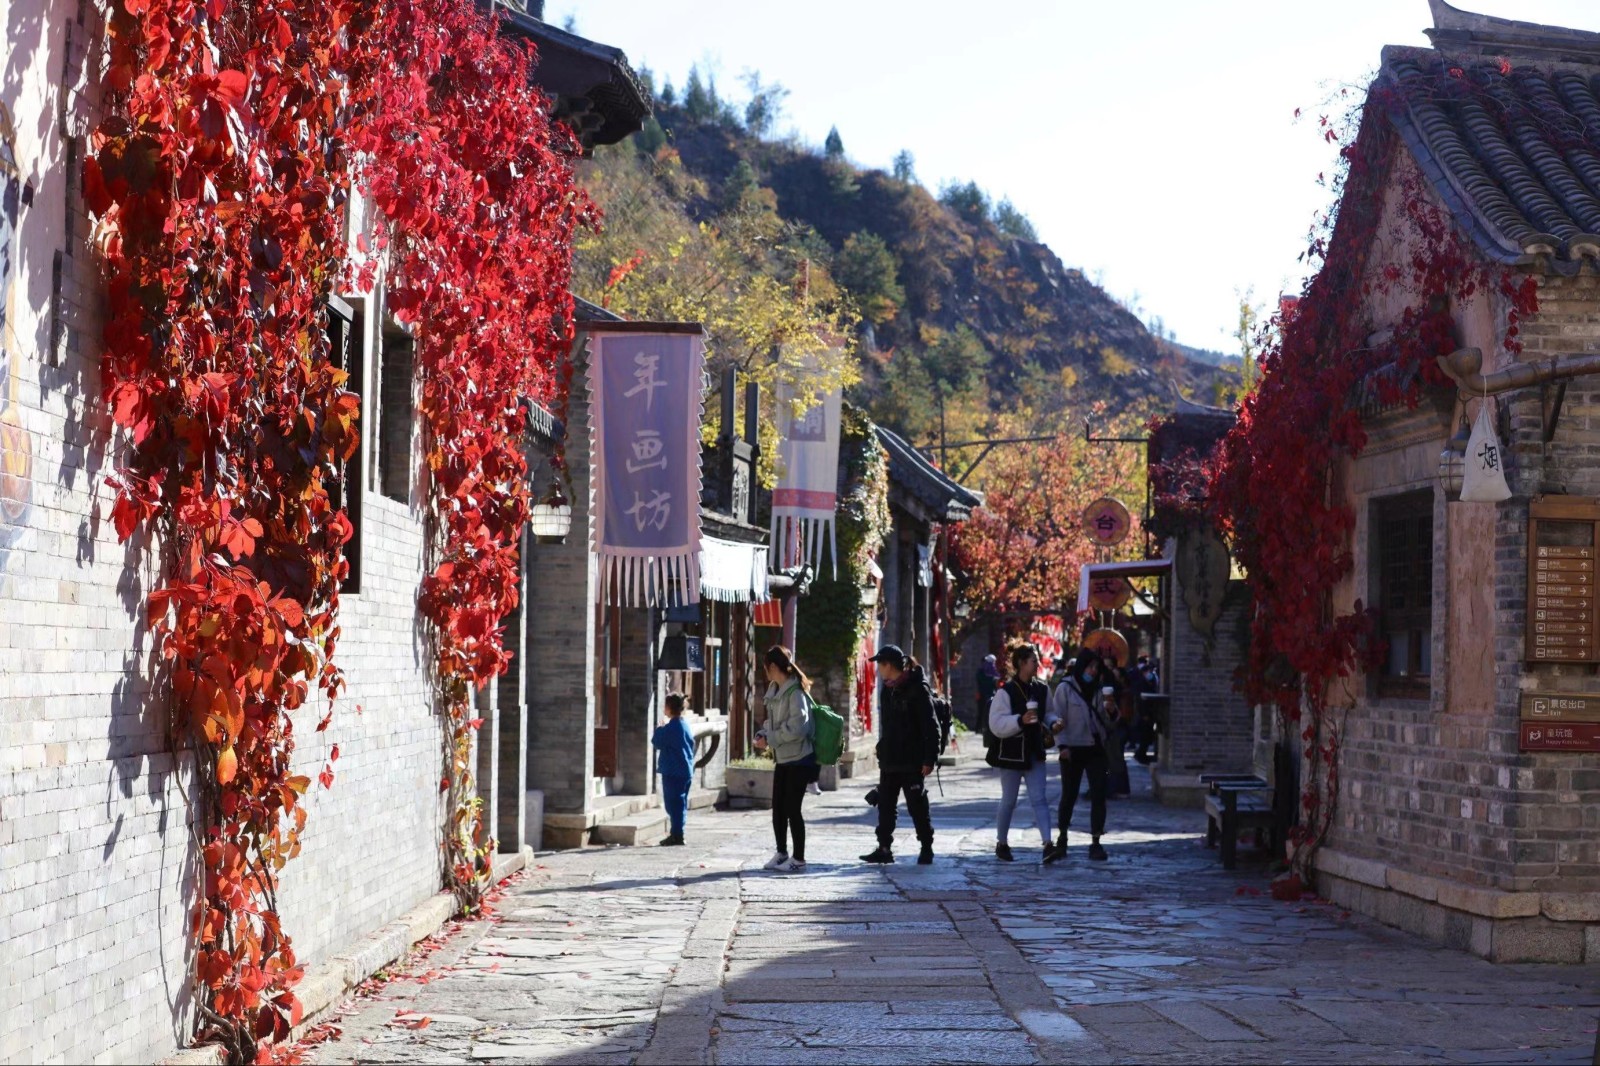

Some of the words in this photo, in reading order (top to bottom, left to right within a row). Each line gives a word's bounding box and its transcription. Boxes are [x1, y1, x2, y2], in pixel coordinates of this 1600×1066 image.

[624, 351, 671, 532] 年画坊
[1550, 699, 1586, 709] 景区出口
